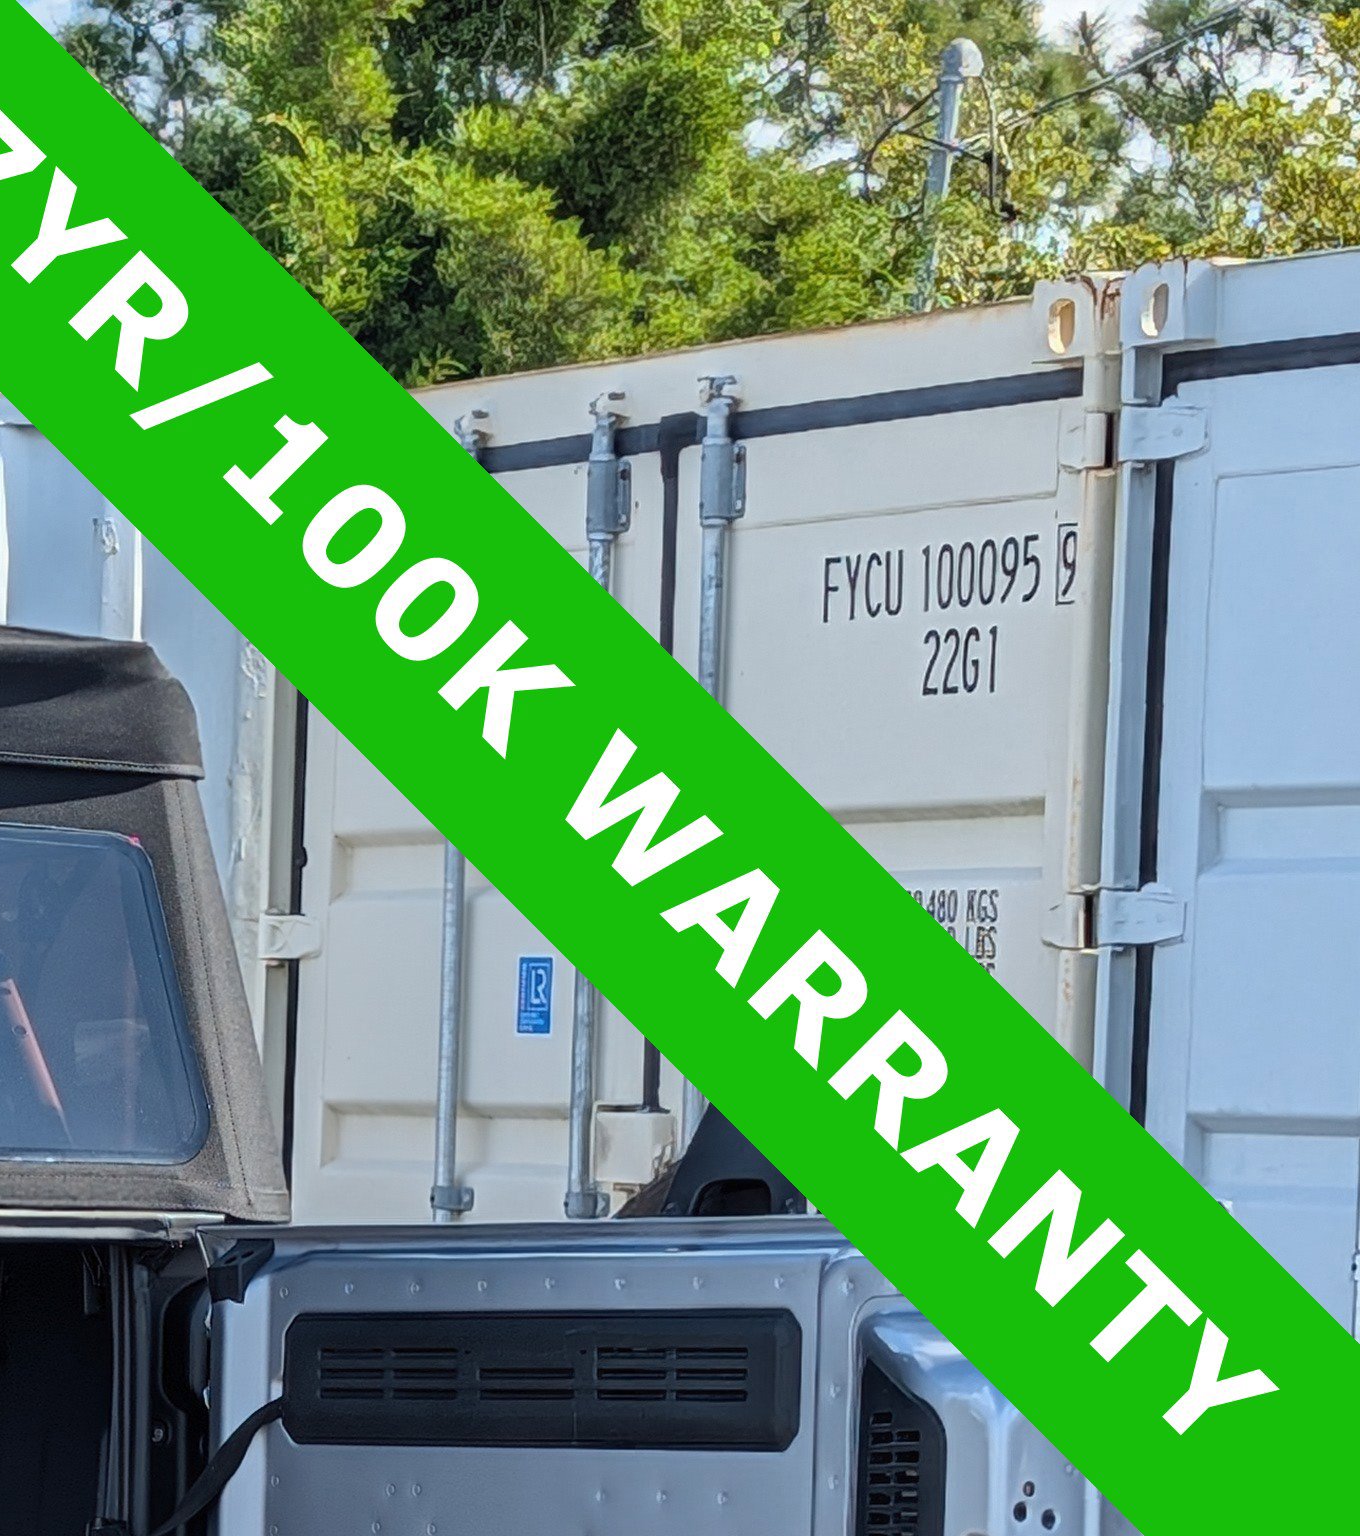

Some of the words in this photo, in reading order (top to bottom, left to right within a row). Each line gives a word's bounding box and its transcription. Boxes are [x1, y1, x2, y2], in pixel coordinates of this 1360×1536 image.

[822, 549, 904, 624] FYCU
[922, 534, 1041, 612] 100095
[1061, 530, 1078, 597] 9
[922, 625, 999, 696] 22G1
[966, 889, 999, 923] KGS
